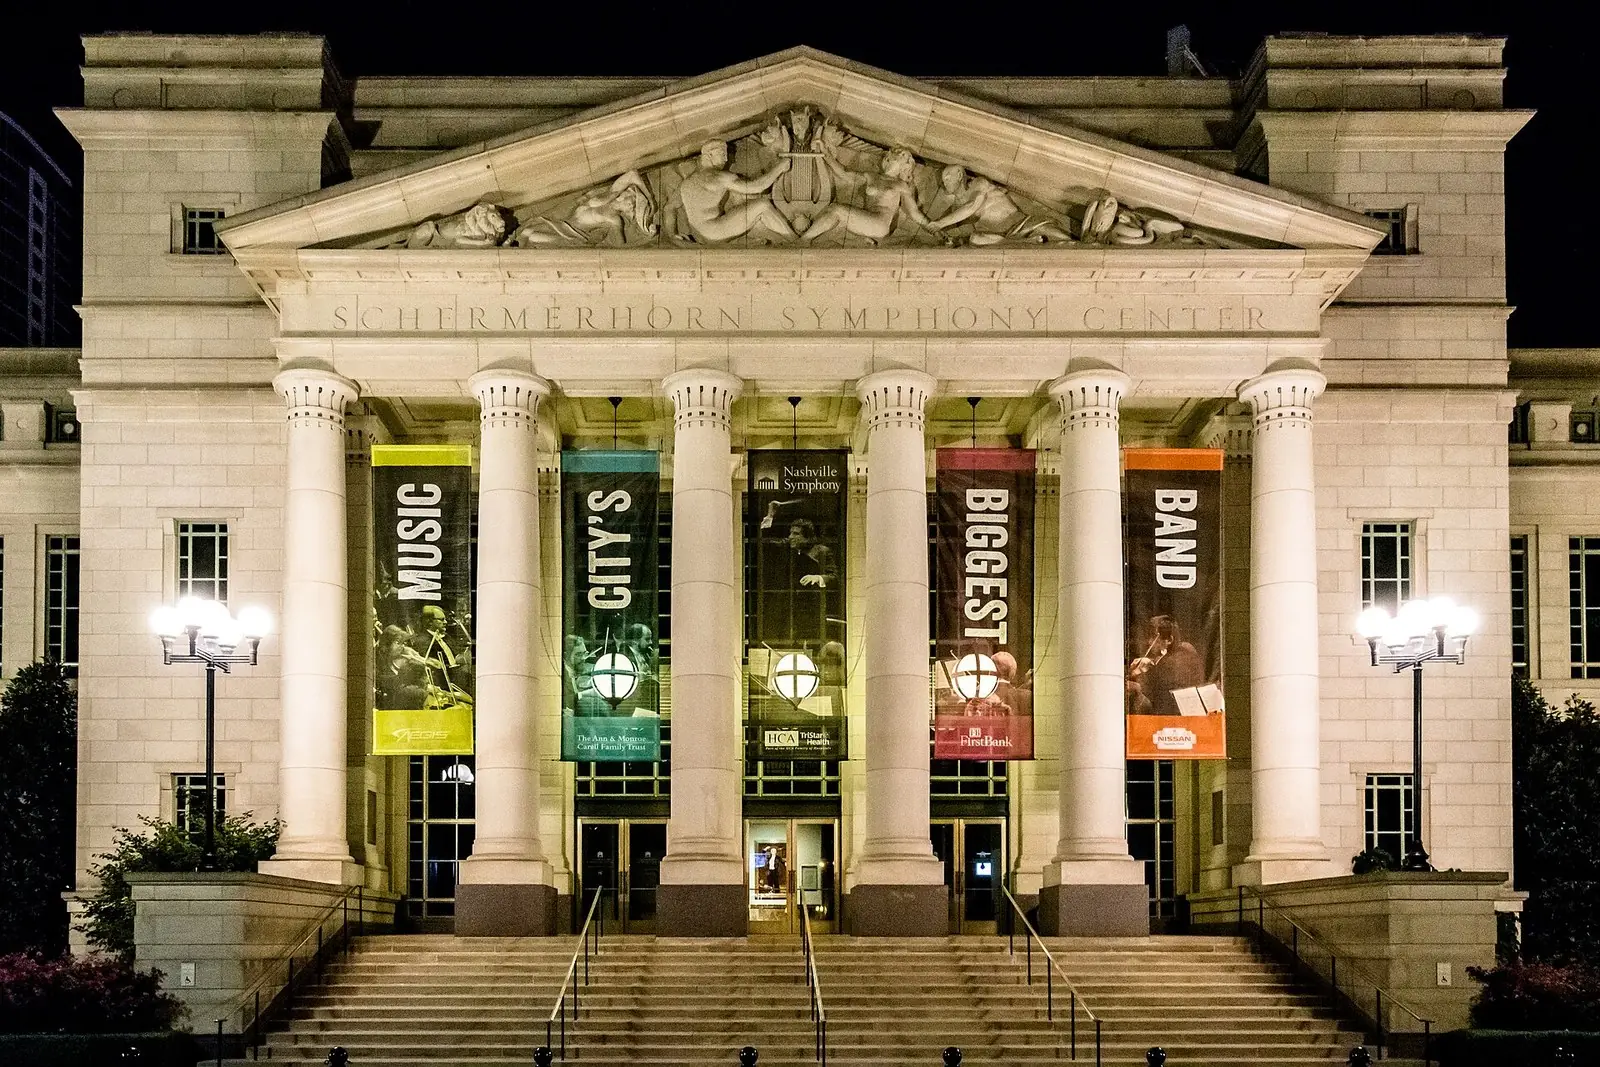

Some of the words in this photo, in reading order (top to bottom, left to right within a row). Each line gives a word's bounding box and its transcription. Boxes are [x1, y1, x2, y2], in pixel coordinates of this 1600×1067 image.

[332, 306, 743, 330] SCHERMERHORN
[780, 306, 1048, 330] SYMPHONY
[1083, 306, 1269, 330] CENTER
[784, 465, 838, 477] Nashville
[784, 478, 841, 494] Symphony
[396, 483, 442, 601] MUSIC
[1154, 489, 1198, 589] BAND
[587, 489, 632, 610] CITY'S
[964, 488, 1009, 645] BIGGEST
[768, 733, 795, 744] HCA
[800, 731, 823, 739] TriStar
[806, 738, 830, 746] Health
[960, 735, 1013, 747] FirstBank
[601, 743, 626, 752] Family
